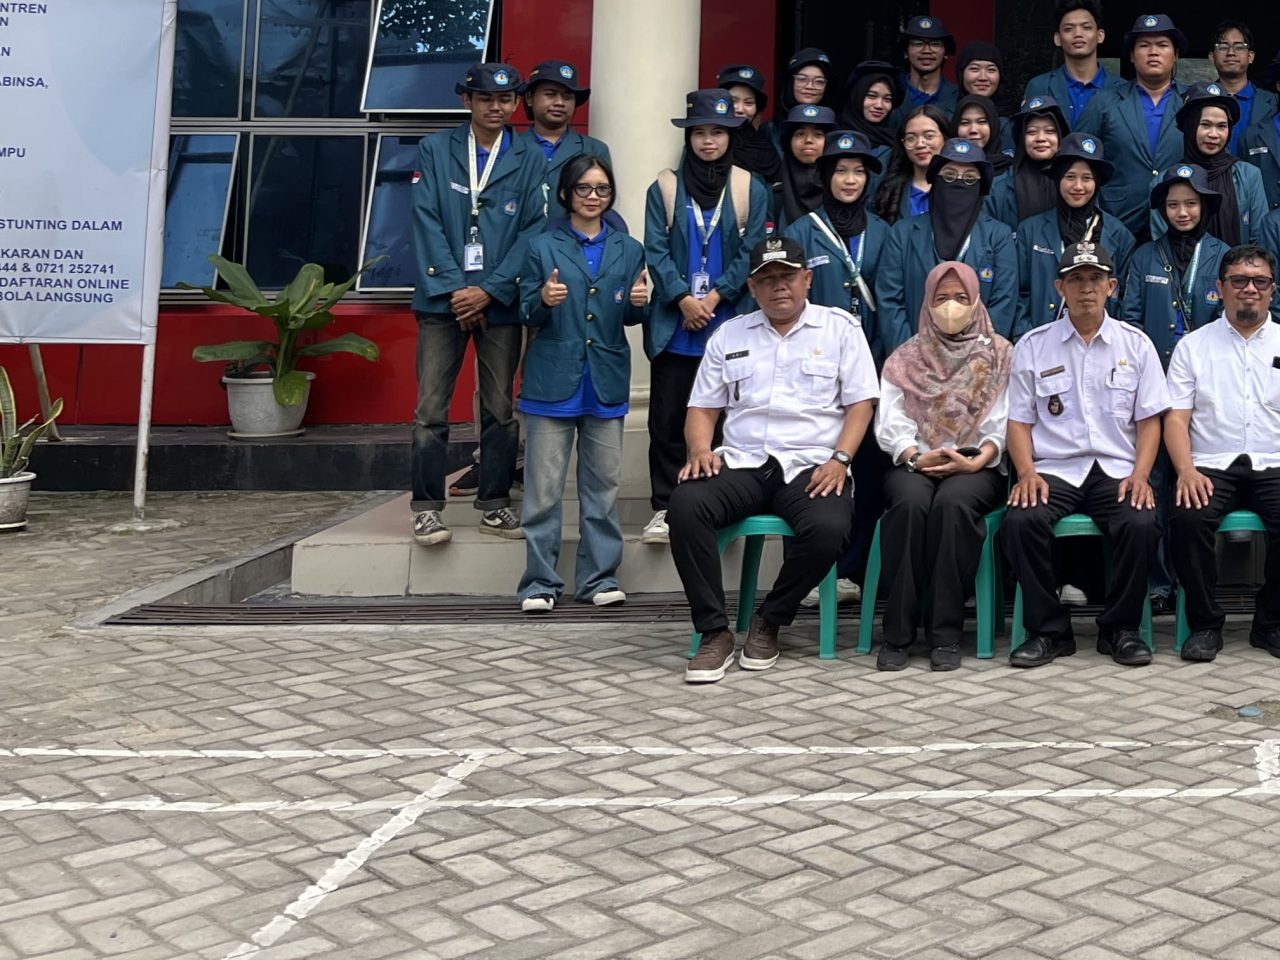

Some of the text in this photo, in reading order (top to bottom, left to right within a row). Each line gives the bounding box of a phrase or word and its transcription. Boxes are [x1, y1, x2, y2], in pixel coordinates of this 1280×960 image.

[0, 2, 47, 14] NTREN
[0, 76, 49, 89] BINSA,
[0, 219, 122, 231] STUNTING DALAM
[0, 248, 83, 259] KARAN DAN
[22, 262, 31, 273] &
[36, 263, 64, 274] 0721
[69, 264, 114, 274] 252741
[0, 277, 130, 290] DAFTARAN ONLINE
[36, 292, 113, 303] LANGSUNG
